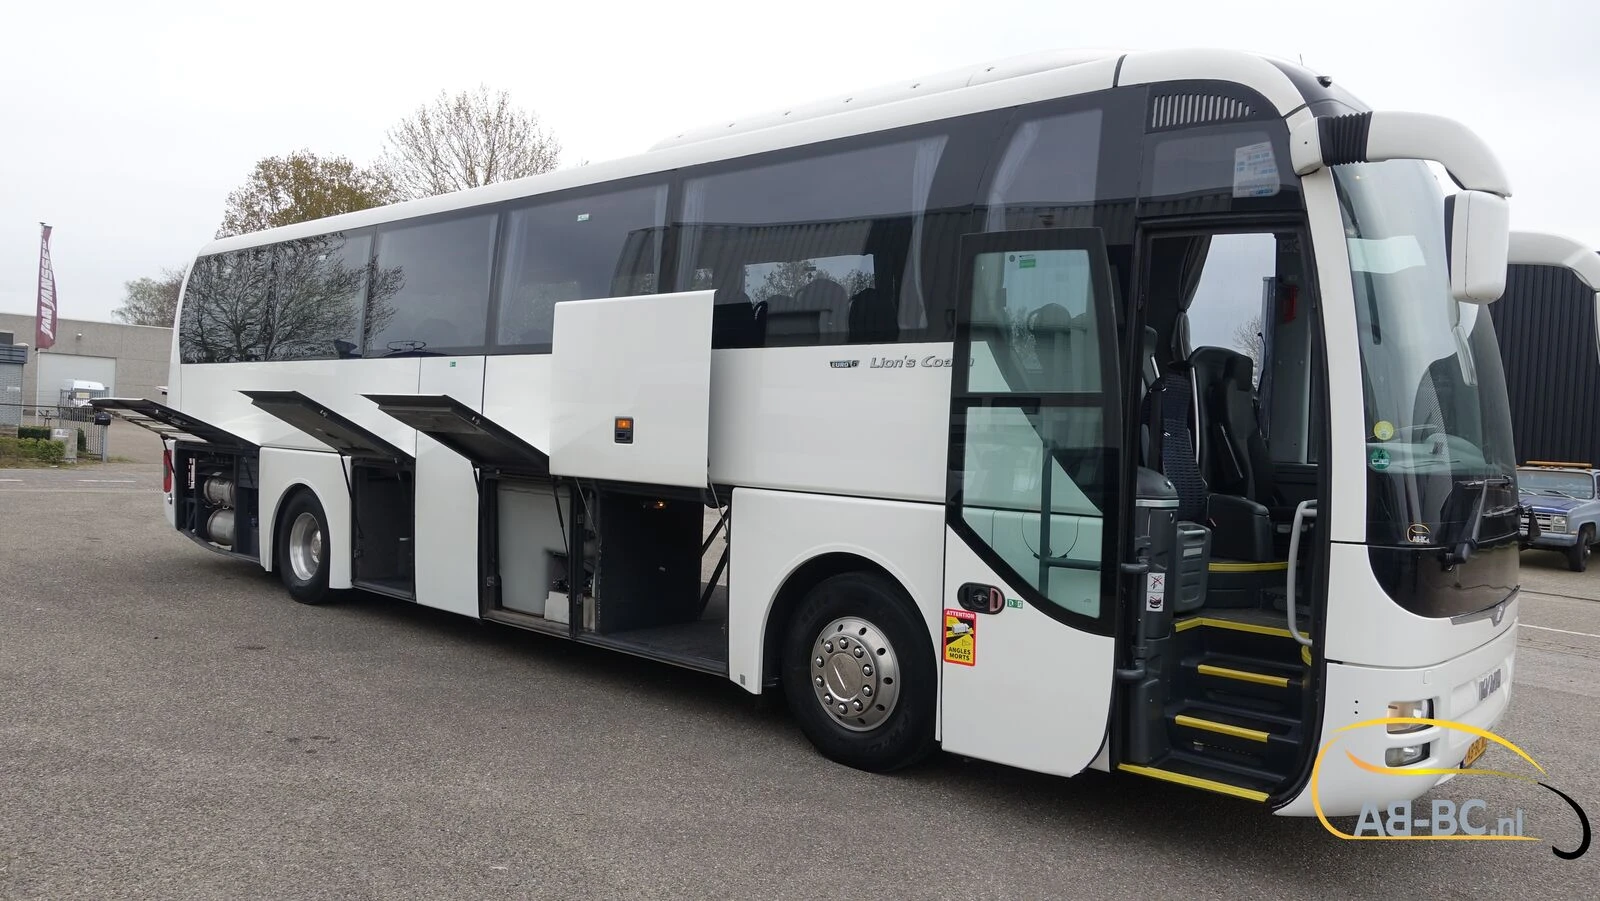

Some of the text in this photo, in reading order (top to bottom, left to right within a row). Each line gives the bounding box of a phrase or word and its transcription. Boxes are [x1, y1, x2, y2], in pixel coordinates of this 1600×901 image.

[40, 306, 55, 340] JAN
[870, 355, 974, 368] Lion's Coa
[946, 610, 975, 619] ATTENTION
[948, 646, 971, 655] ANGLES
[949, 652, 970, 661] MORTS
